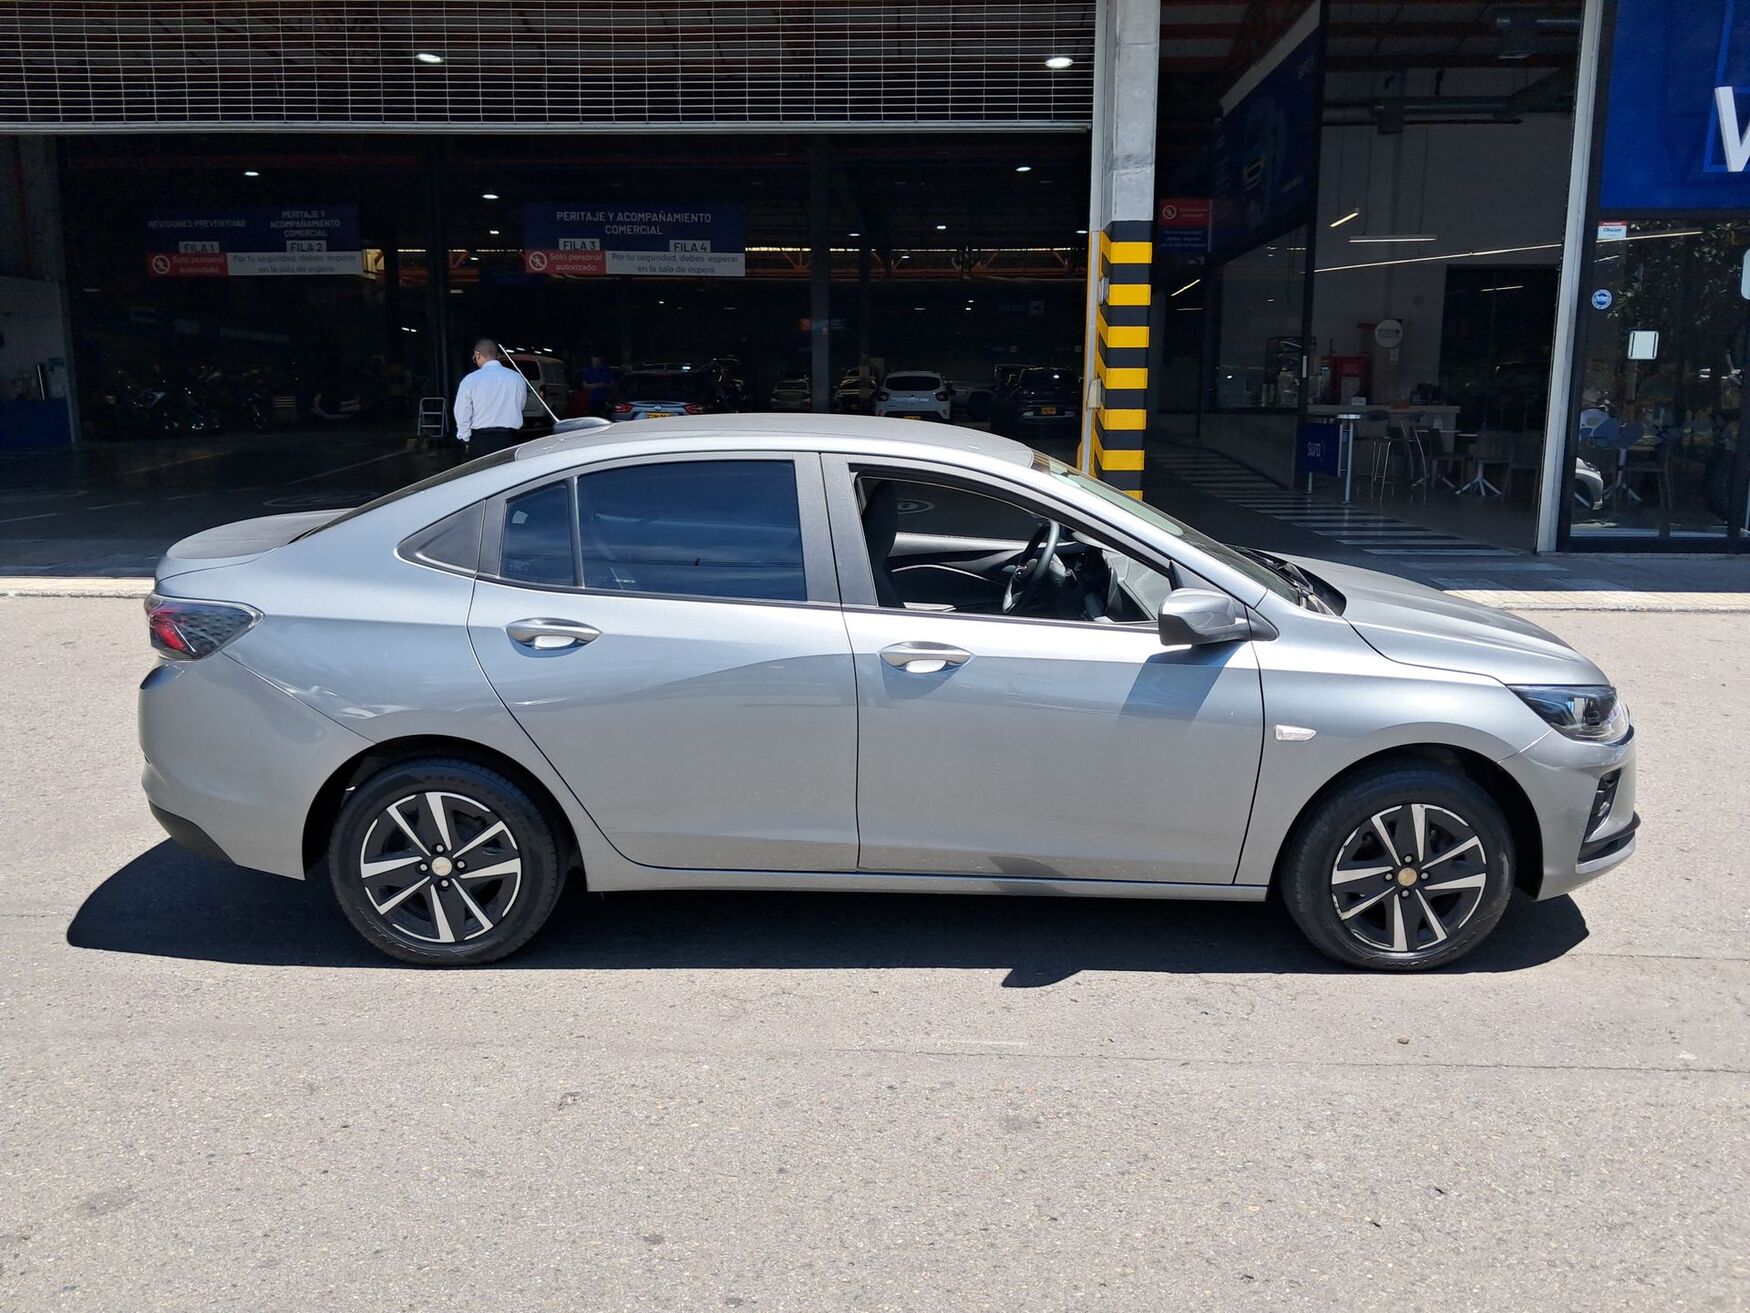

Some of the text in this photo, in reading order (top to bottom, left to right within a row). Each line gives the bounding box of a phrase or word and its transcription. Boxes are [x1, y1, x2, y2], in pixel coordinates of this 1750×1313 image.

[282, 210, 319, 218] PERITAJE
[557, 210, 712, 223] PERITAJE Y ACOMPAÑAMIENTO
[194, 219, 246, 228] PREVENTIVAS
[269, 218, 341, 228] ACOMPAÑAMIENTO
[284, 229, 328, 237] COMERCIAL
[605, 225, 664, 235] COMERCIAL
[185, 243, 208, 253] FILA
[291, 242, 322, 252] FILA 2
[563, 241, 597, 251] FILA 3
[674, 242, 708, 252] FILA 4
[549, 253, 602, 262] Solo personal
[626, 253, 636, 261] tu
[707, 255, 738, 264] esperar
[556, 263, 597, 271] autorizado
[650, 265, 657, 273] la
[658, 265, 674, 273] sala
[675, 265, 687, 273] de
[688, 266, 716, 274] espera
